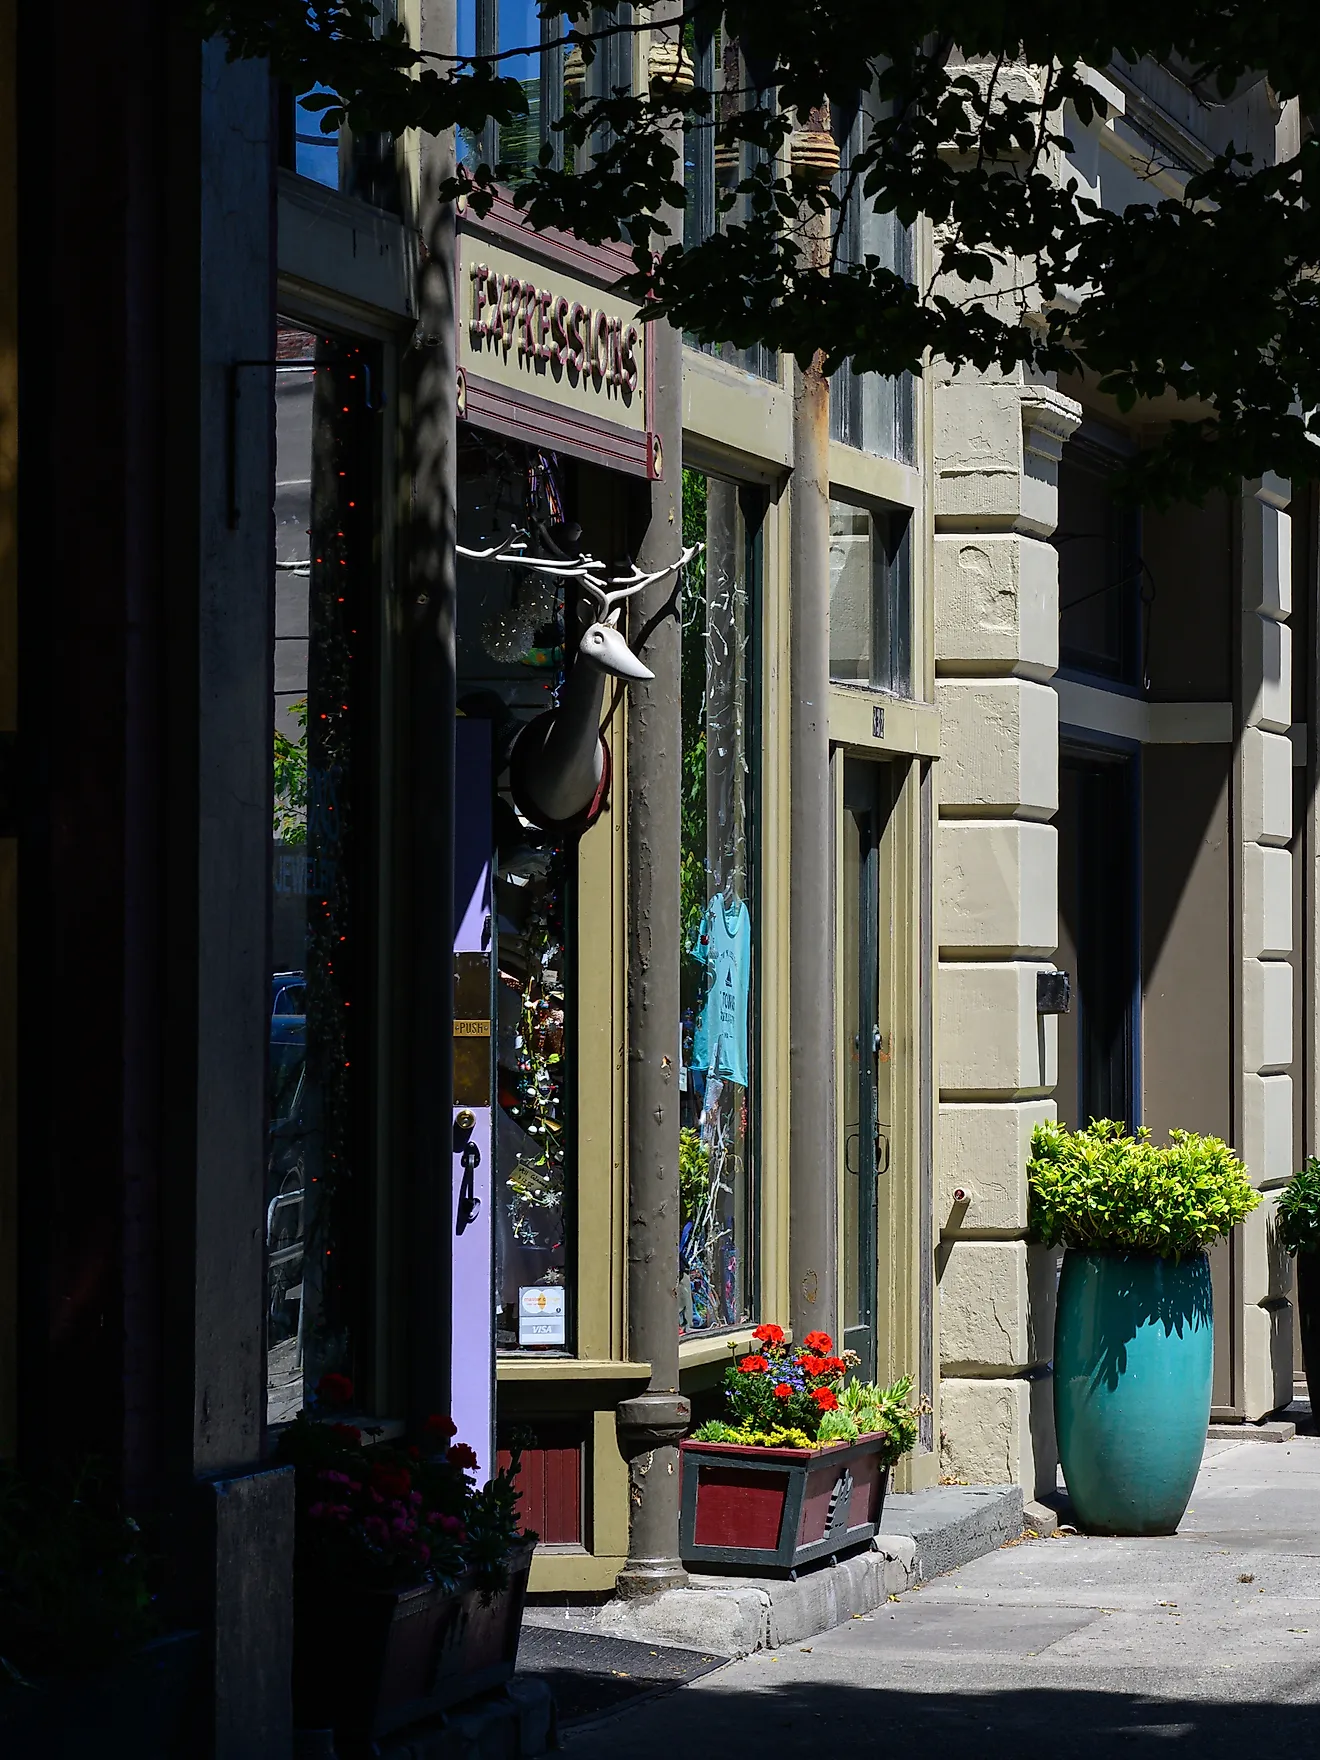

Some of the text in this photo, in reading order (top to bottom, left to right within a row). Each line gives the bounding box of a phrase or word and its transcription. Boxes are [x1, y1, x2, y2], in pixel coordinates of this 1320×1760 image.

[469, 262, 638, 394] EXPRESSIONS
[460, 1022, 483, 1034] PUSH
[532, 1325, 552, 1334] VISA
